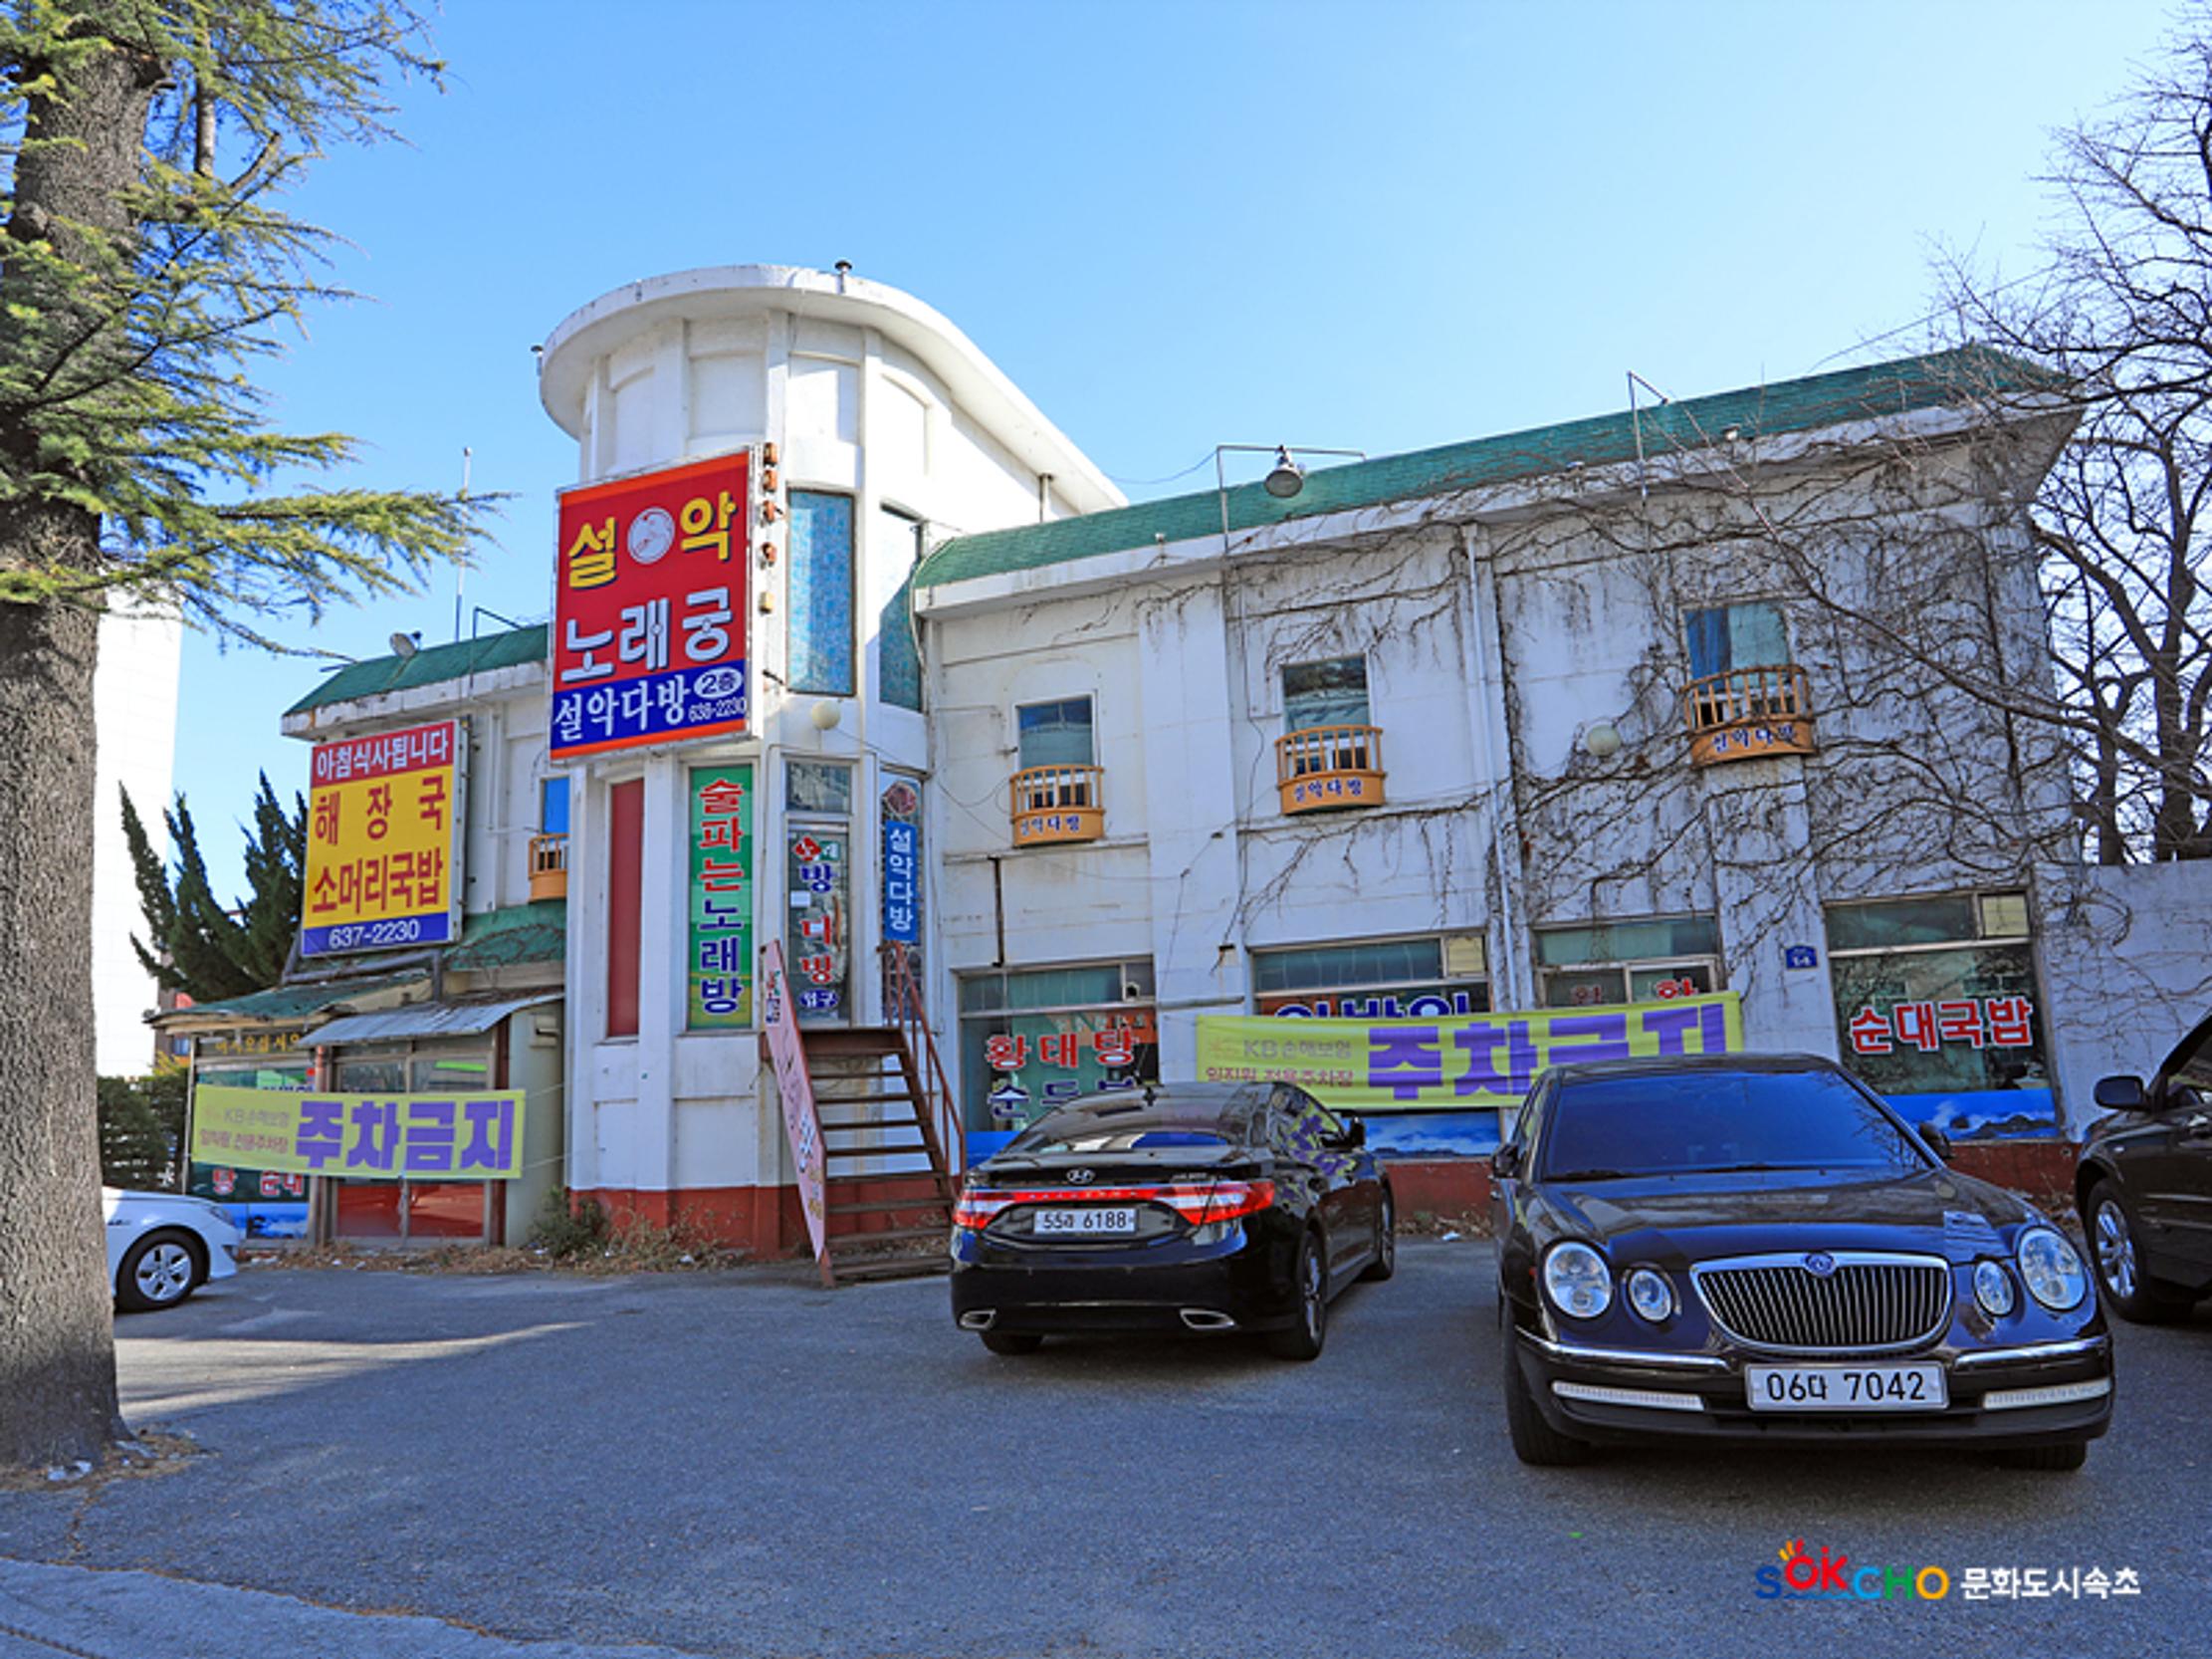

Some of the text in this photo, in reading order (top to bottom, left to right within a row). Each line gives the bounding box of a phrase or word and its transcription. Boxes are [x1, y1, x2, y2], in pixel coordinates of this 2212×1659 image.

[568, 491, 738, 589] 설악
[560, 587, 733, 683] 노래궁
[554, 673, 691, 742] 설악다방
[317, 728, 449, 782] 아침식사됩니다
[314, 775, 446, 846] 해장국
[311, 846, 444, 915] 소머리국밥
[698, 778, 745, 1015] 술파는 노래방
[328, 918, 421, 949] 637-2230
[986, 1027, 1140, 1071] 황태탕
[1849, 996, 2034, 1056] 순대국밥
[296, 1099, 516, 1171] 주차금지
[1082, 1210, 1128, 1230] 6188
[1843, 1370, 1926, 1402] 7042
